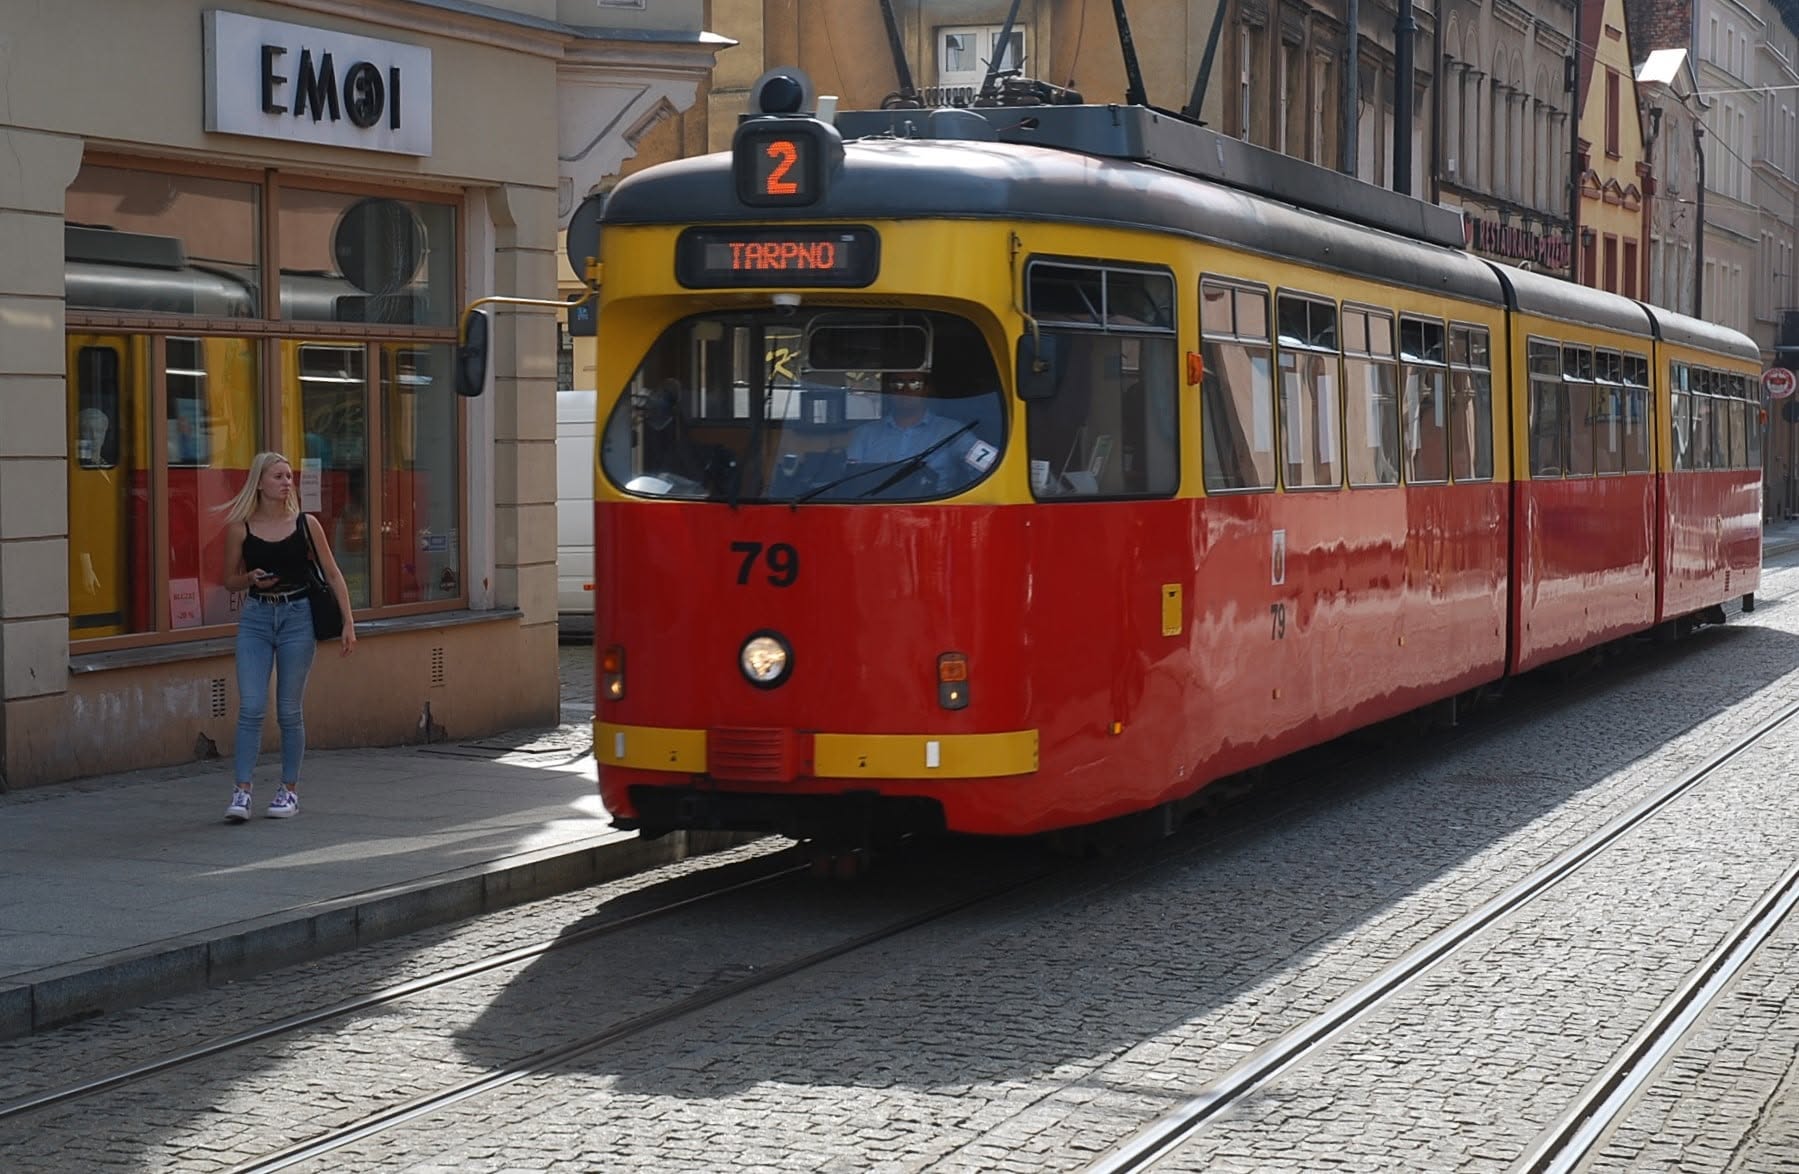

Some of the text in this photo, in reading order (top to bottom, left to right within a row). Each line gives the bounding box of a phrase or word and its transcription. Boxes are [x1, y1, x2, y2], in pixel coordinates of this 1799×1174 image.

[261, 44, 401, 130] EMOI
[766, 140, 798, 195] 2
[729, 242, 836, 270] TARPNO
[975, 447, 990, 462] 7
[730, 541, 800, 589] 79
[1271, 603, 1286, 641] 79
